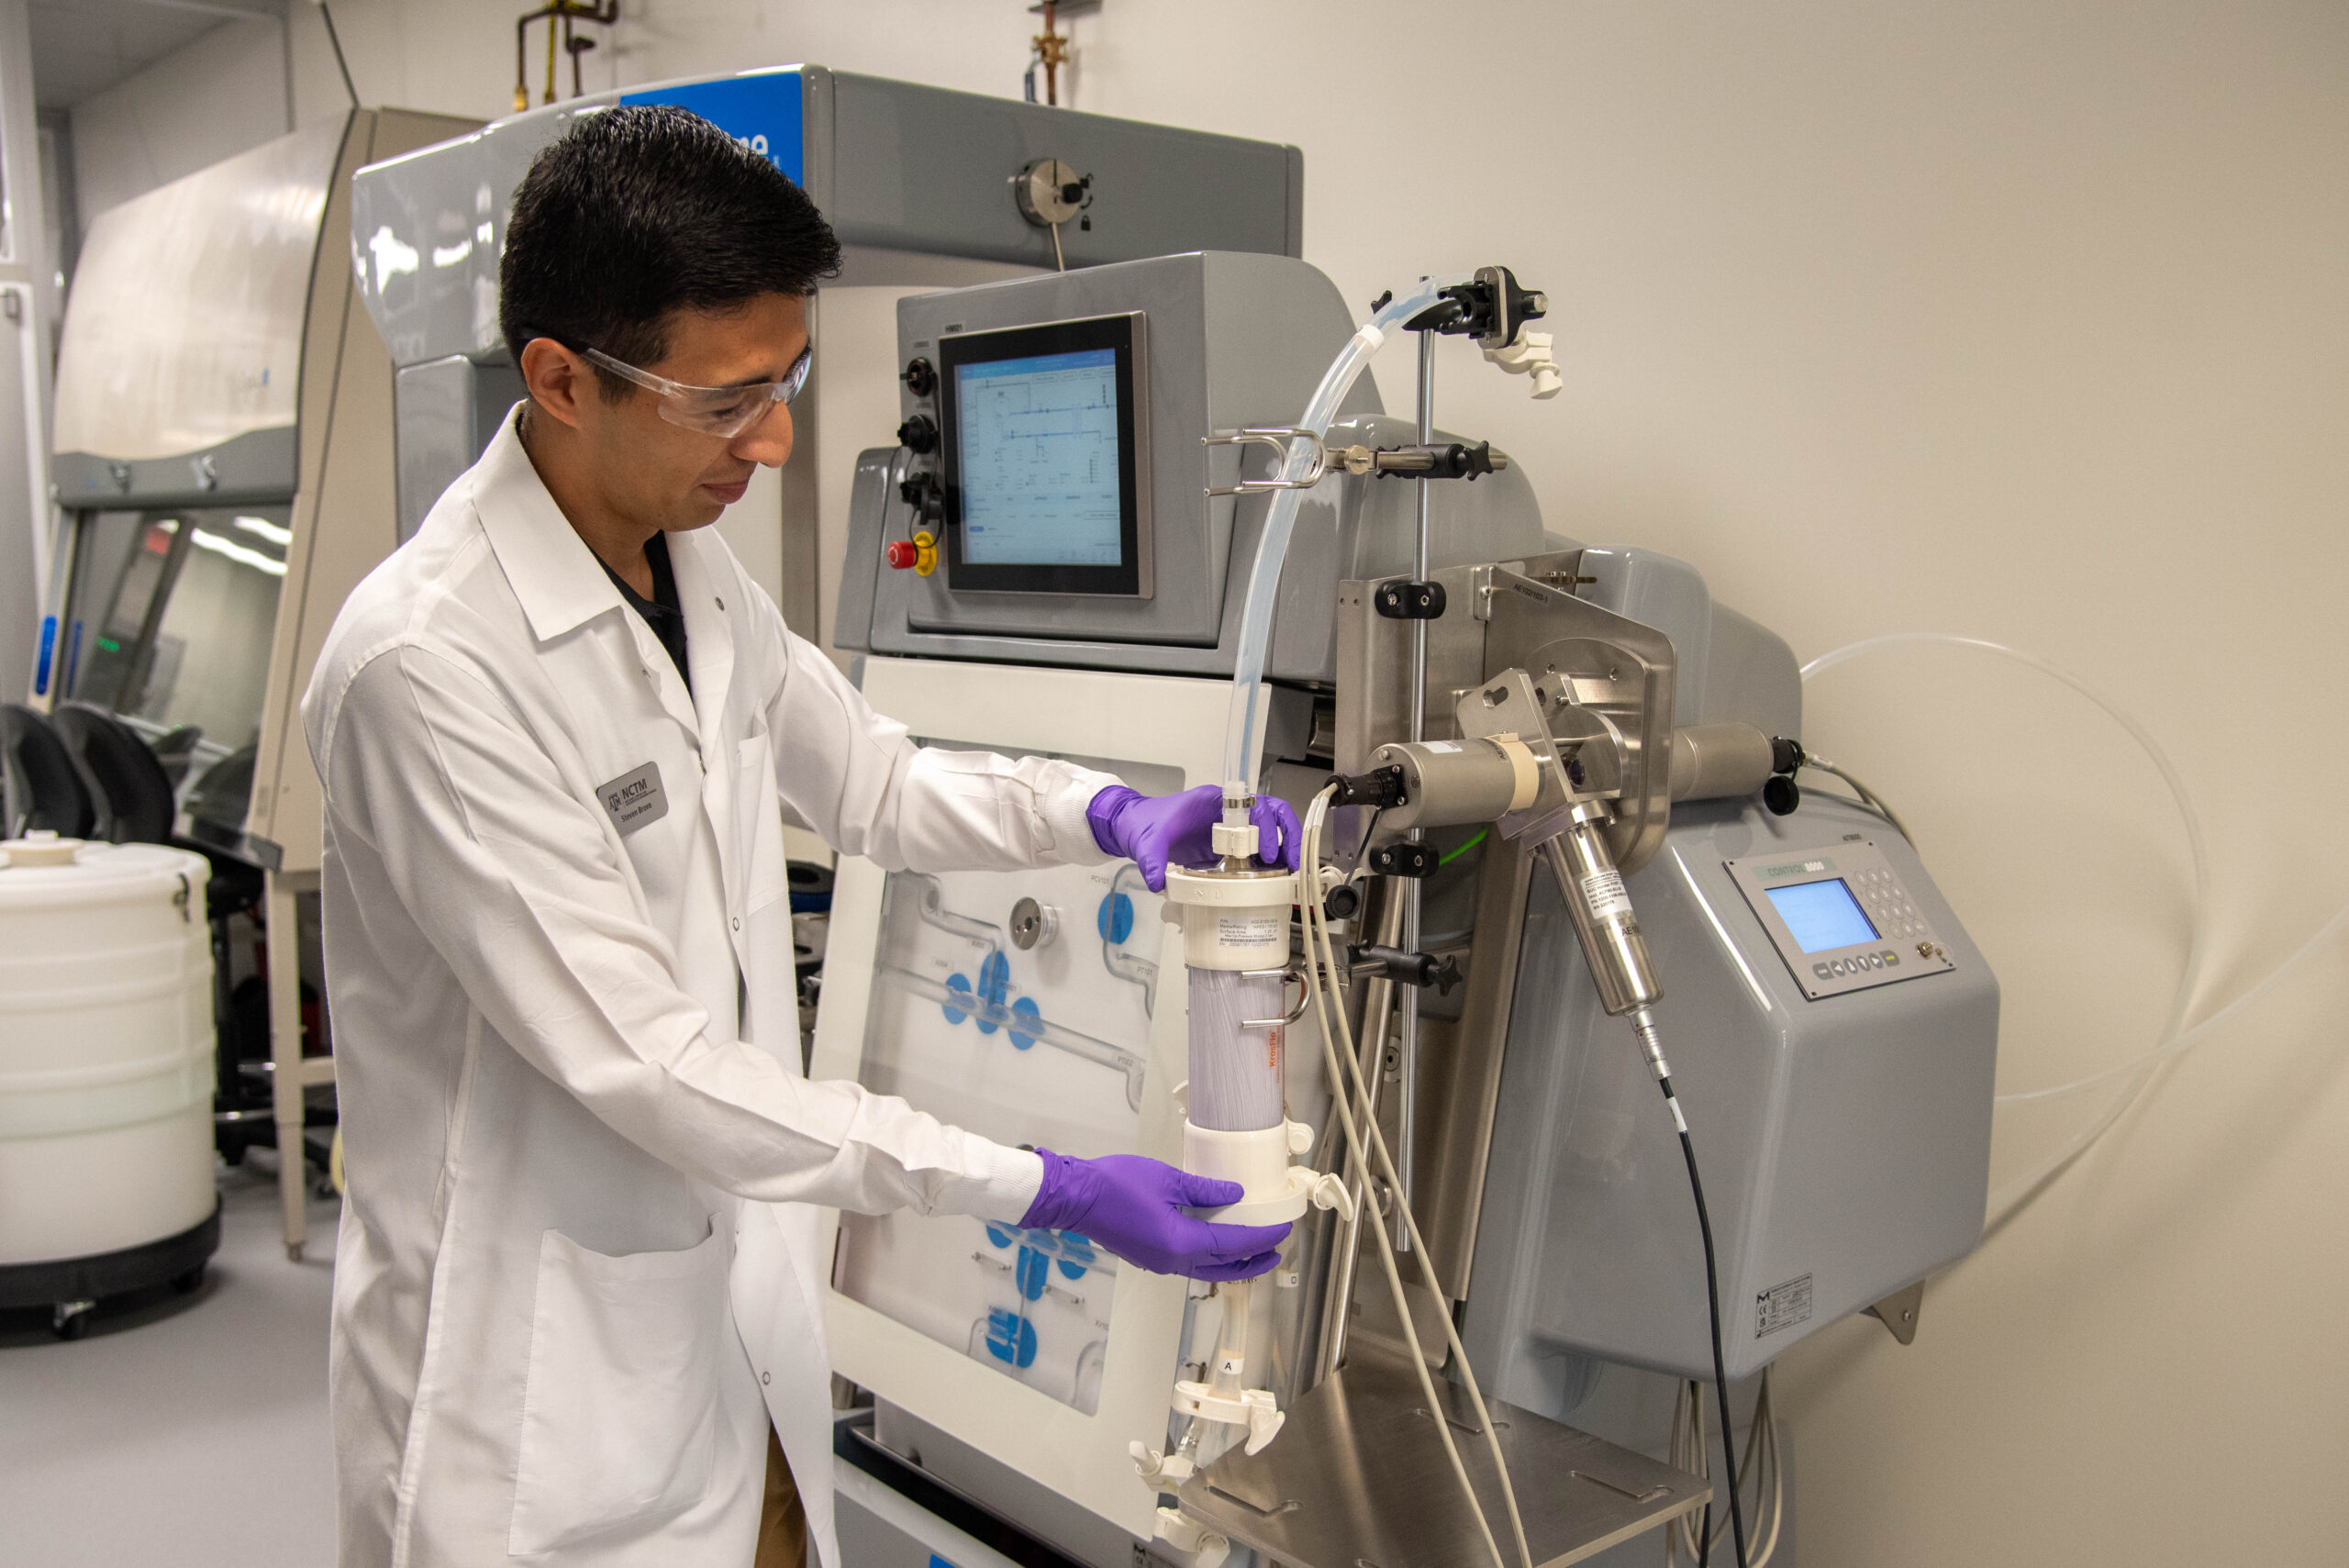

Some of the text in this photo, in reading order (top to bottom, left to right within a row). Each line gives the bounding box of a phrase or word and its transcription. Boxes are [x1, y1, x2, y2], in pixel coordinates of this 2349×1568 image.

[621, 778, 647, 799] NCTM
[621, 809, 639, 822] Steven
[1224, 1362, 1232, 1372] A
